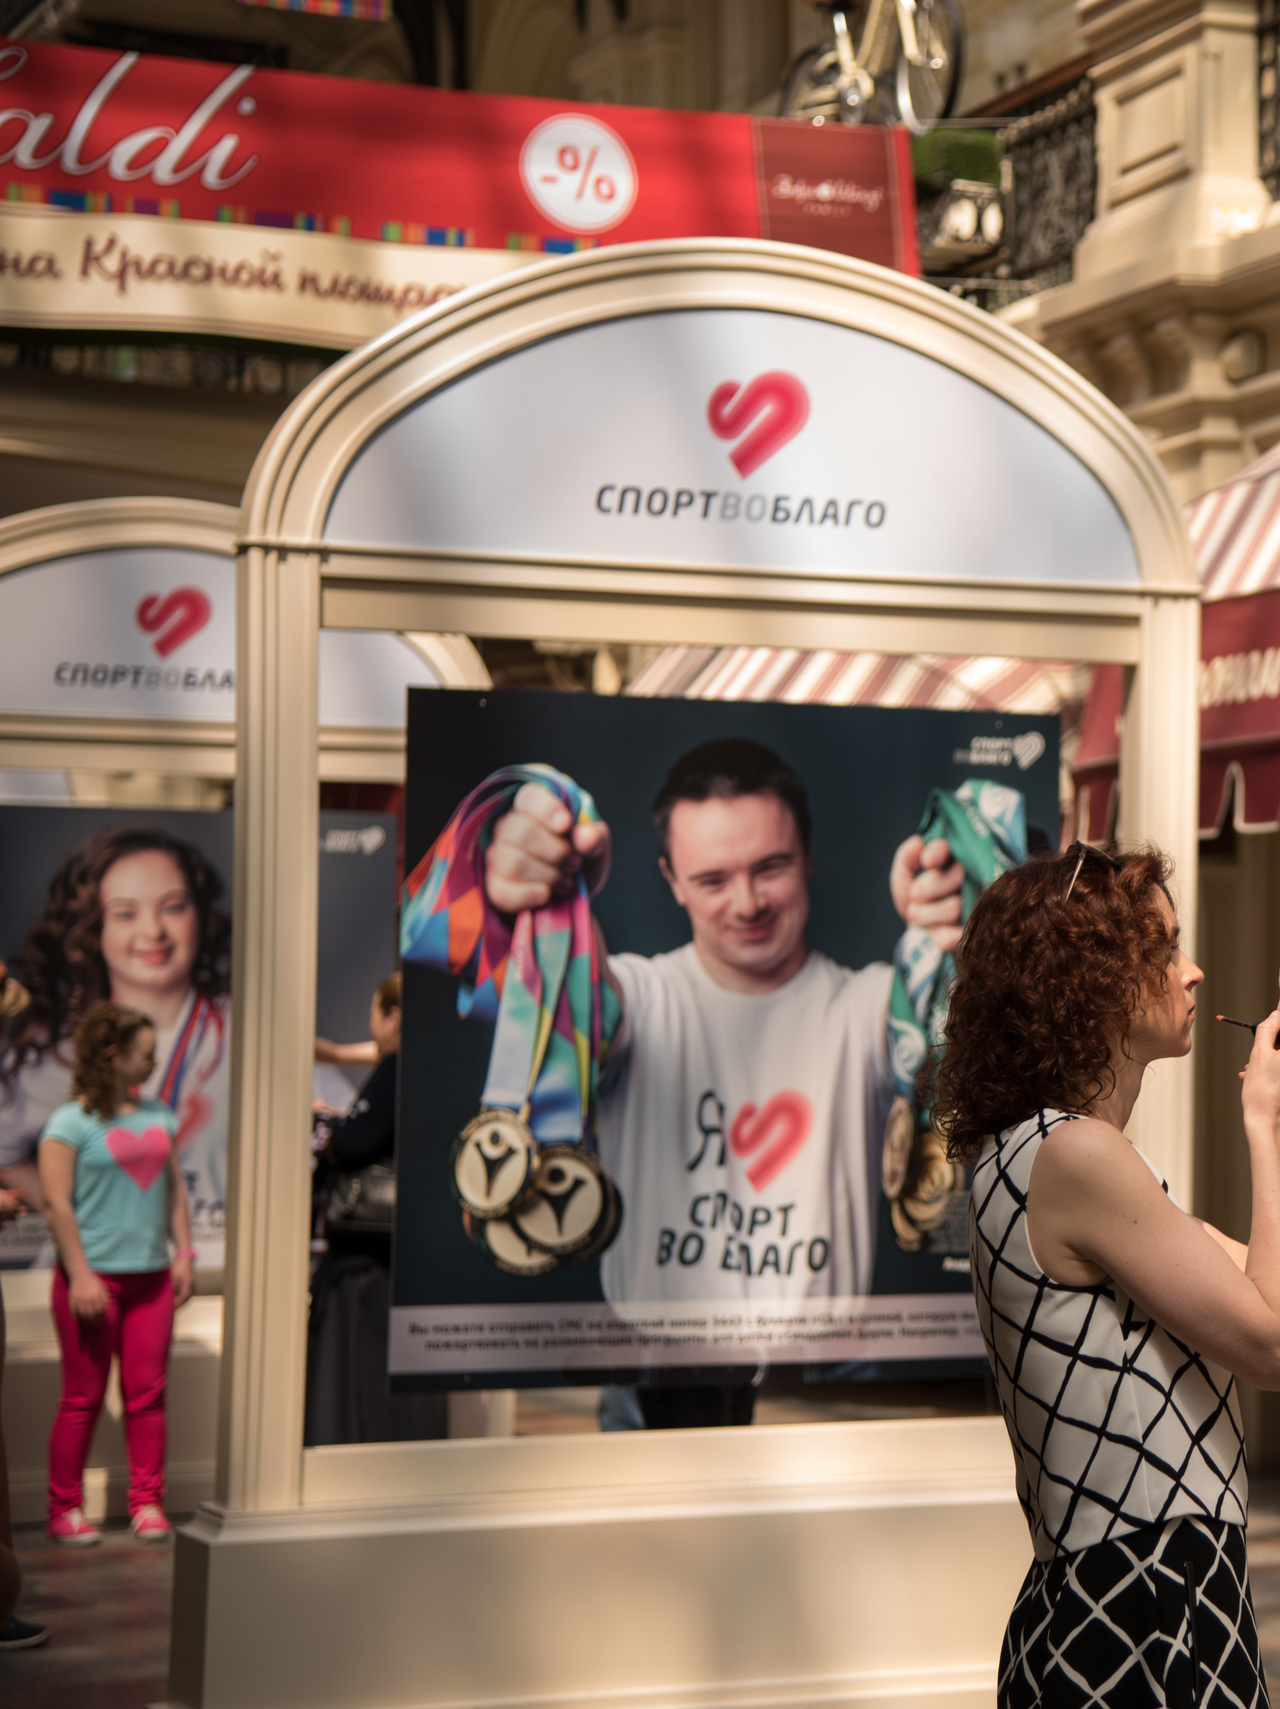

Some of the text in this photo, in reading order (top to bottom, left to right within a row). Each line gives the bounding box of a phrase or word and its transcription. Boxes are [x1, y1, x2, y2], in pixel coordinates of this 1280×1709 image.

[0, 46, 259, 191] aldi
[80, 232, 284, 296] Красной
[656, 1227, 704, 1267] ВО
